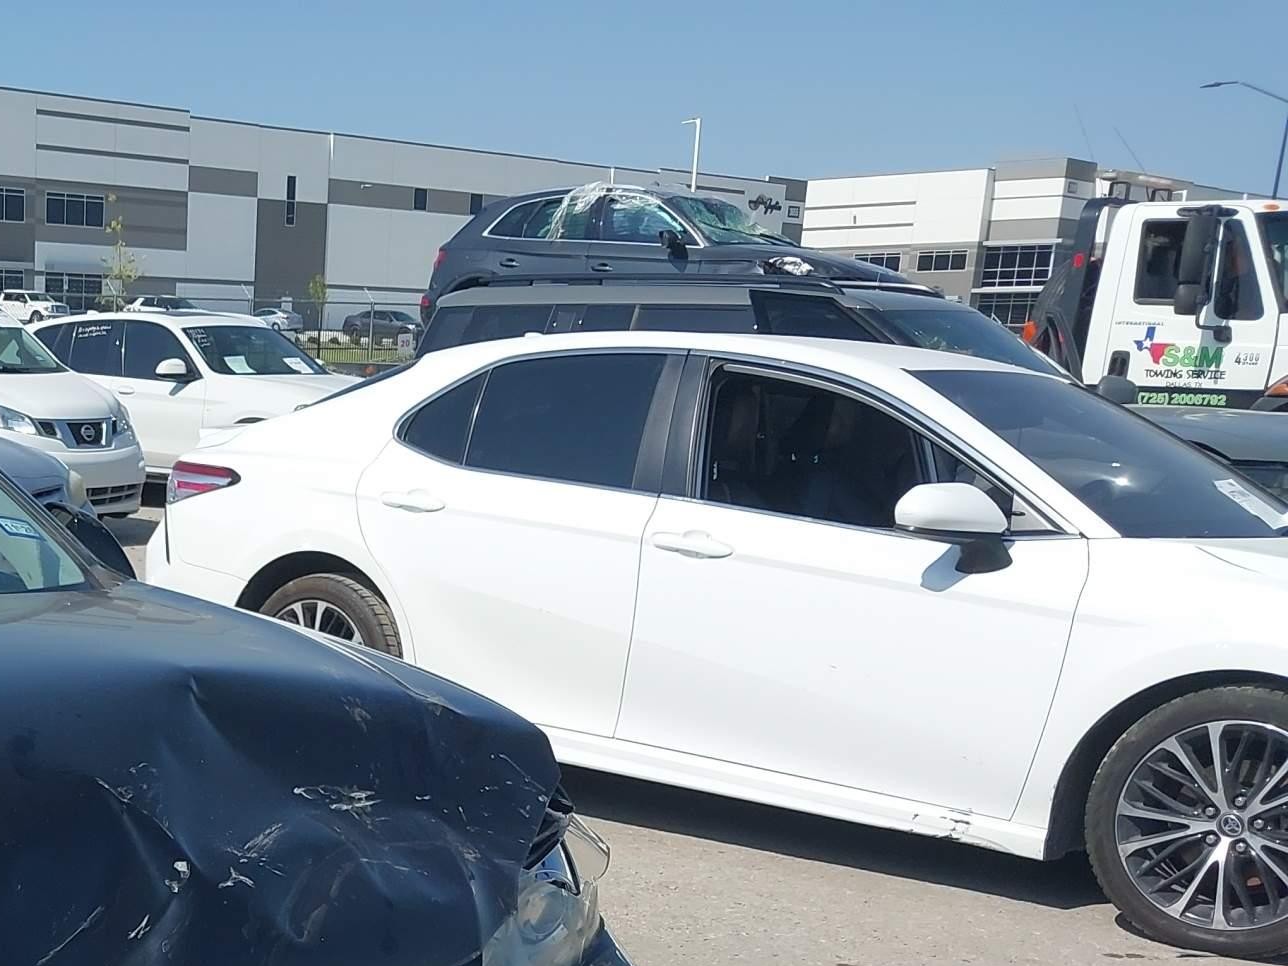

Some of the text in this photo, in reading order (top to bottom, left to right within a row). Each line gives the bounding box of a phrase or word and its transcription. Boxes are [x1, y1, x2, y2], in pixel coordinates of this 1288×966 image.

[1162, 344, 1224, 369] S&M
[1145, 369, 1227, 380] TOWING SERVICE
